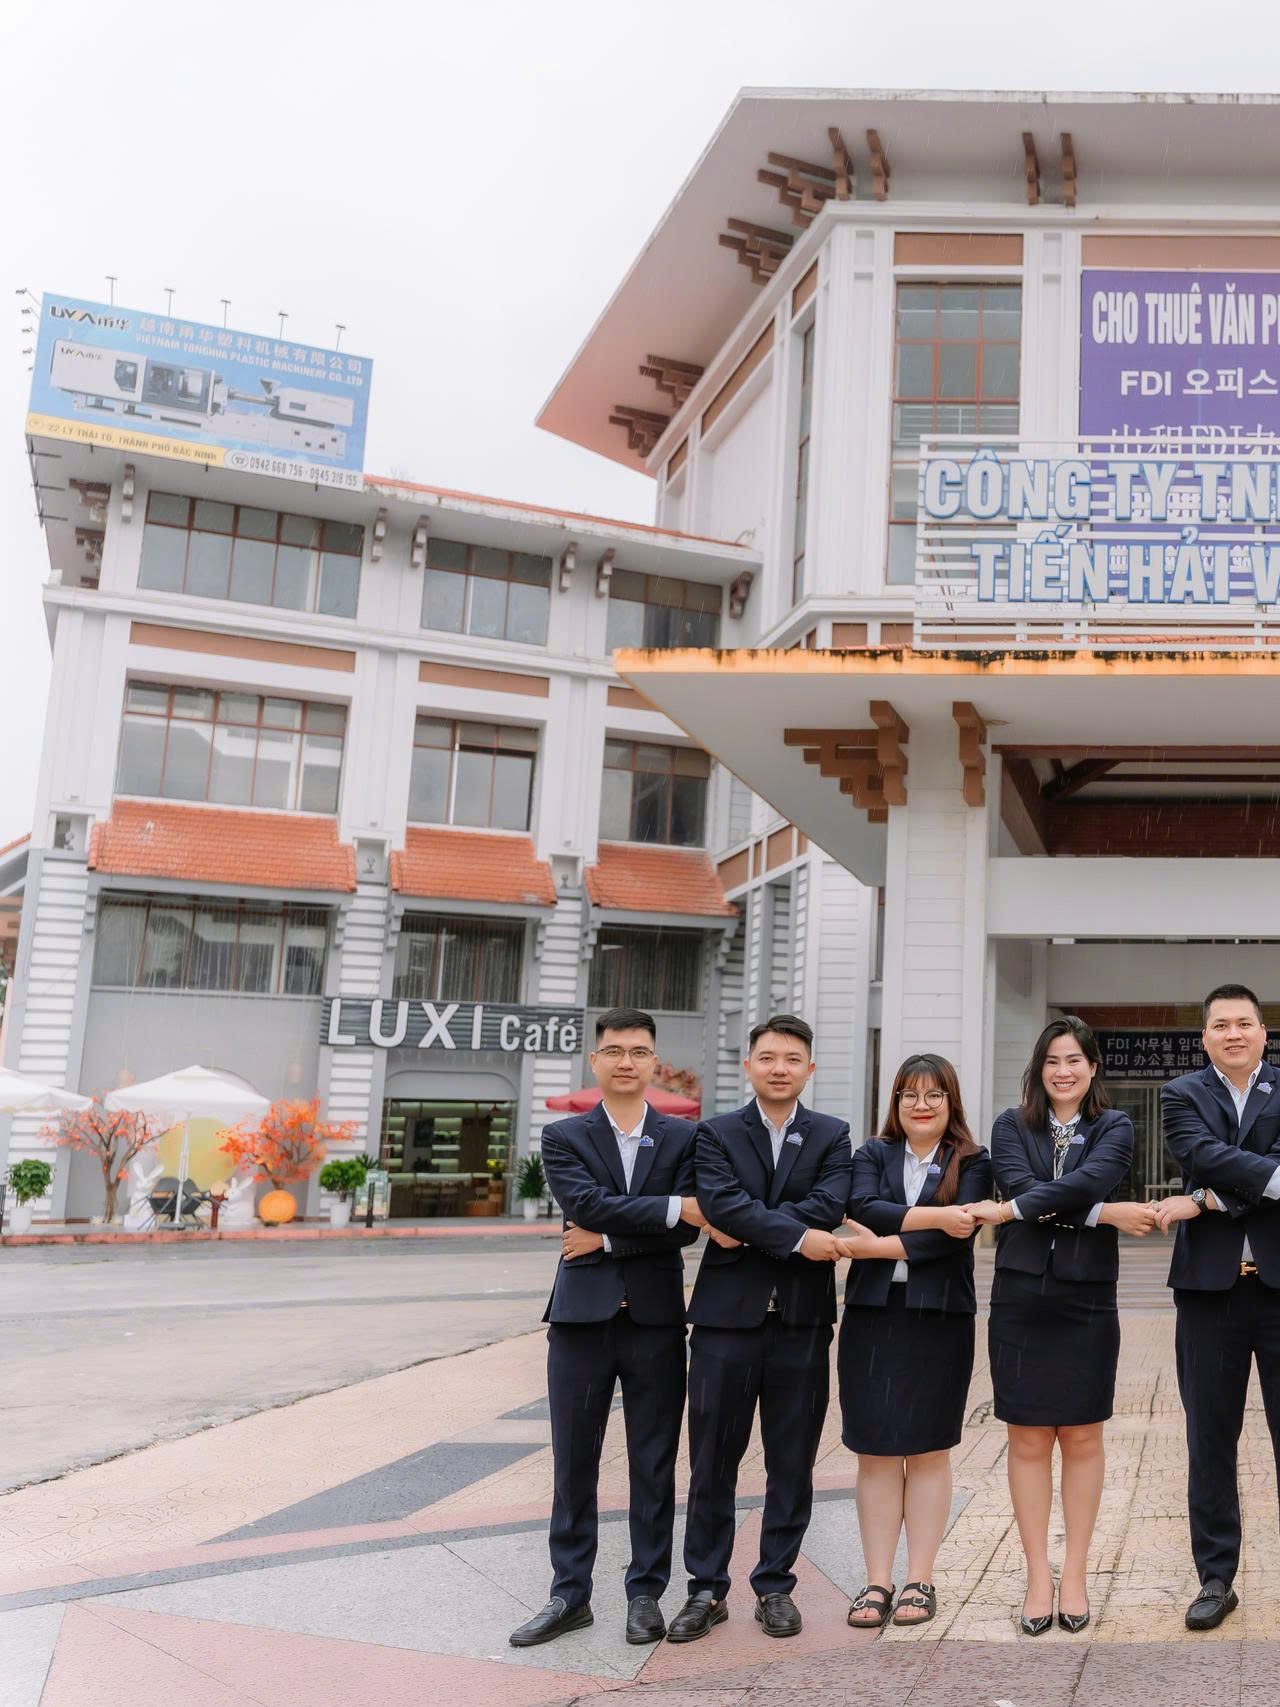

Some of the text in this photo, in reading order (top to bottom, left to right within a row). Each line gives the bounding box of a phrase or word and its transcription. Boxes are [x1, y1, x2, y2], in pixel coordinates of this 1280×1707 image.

[1092, 291, 1139, 344] CHO
[1145, 283, 1202, 345] THUÊ
[1209, 283, 1255, 345] VĂN
[136, 333, 180, 350] VIETNAM
[230, 352, 269, 368] PLASTIC
[272, 360, 327, 377] MACHINERY
[1121, 370, 1172, 396] FDI
[1182, 367, 1279, 399] 오피스
[249, 456, 270, 472] 0942
[310, 467, 330, 481] 0945
[924, 449, 1092, 520] CÔNG
[1107, 461, 1179, 521] TY
[971, 525, 1108, 602] TIẾN
[1128, 526, 1230, 604] HẢI
[327, 998, 578, 1053] LUXI Café
[1107, 1038, 1129, 1050] FDI
[1134, 1038, 1172, 1051] 사무실
[1106, 1053, 1204, 1066] FDI 办公室出租
[1267, 1053, 1280, 1065] FDI
